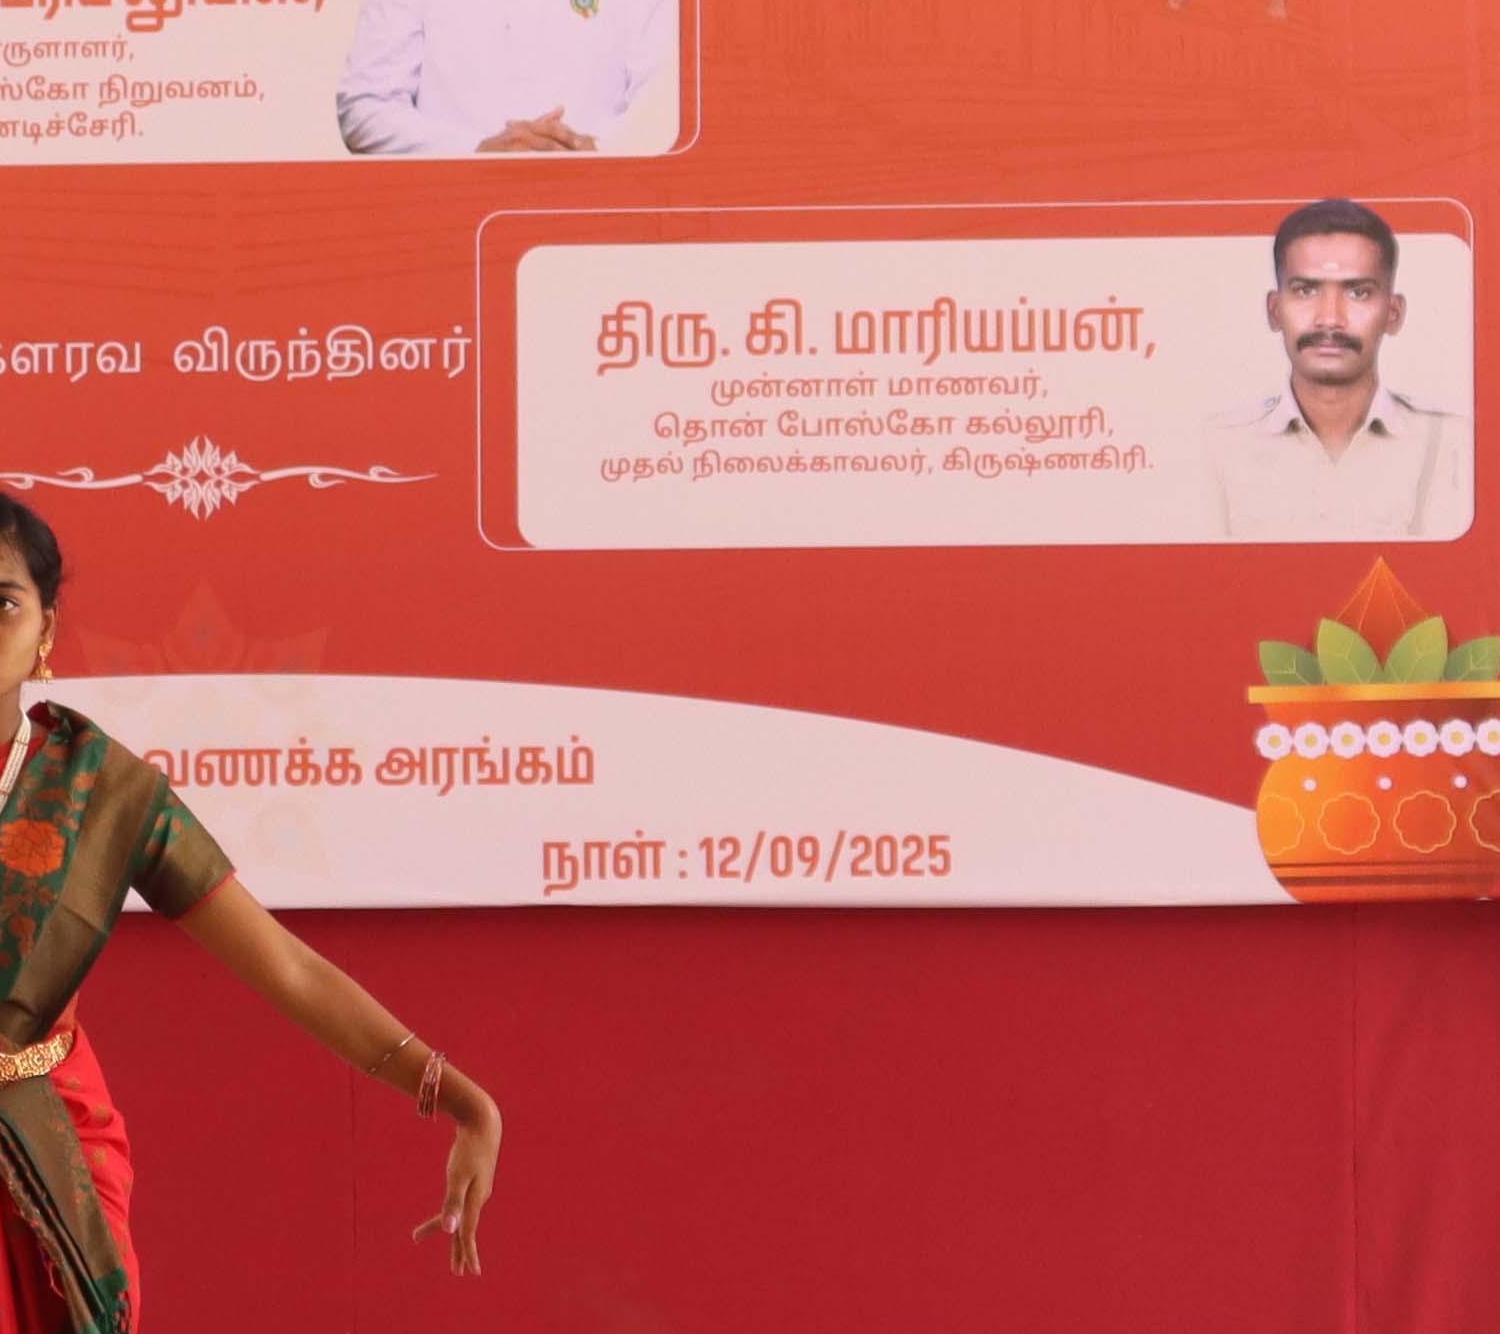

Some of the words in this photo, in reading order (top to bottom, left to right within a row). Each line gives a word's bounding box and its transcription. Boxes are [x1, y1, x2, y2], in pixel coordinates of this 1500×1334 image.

[98, 74, 264, 109] நிறுவனம்,
[174, 324, 472, 381] விருந்தினர்
[597, 301, 729, 376] திரு.
[745, 298, 817, 356] கி.
[835, 296, 1155, 365] மாரியப்பன்,
[711, 371, 877, 407] முன்னாள்
[888, 369, 1047, 400] மாணவர்,
[654, 411, 767, 448] தொன்
[777, 408, 955, 437] போஸ்கோ
[965, 406, 1113, 444] கல்லூரி,
[600, 452, 684, 482] முதல்
[692, 448, 932, 480] நிலைக்காவலர்,
[942, 445, 1153, 479] கிருஷ்ணகிரி.
[375, 735, 594, 796] அரங்கம்
[543, 830, 665, 896] நாள்
[699, 830, 951, 882] 12/09/2025
